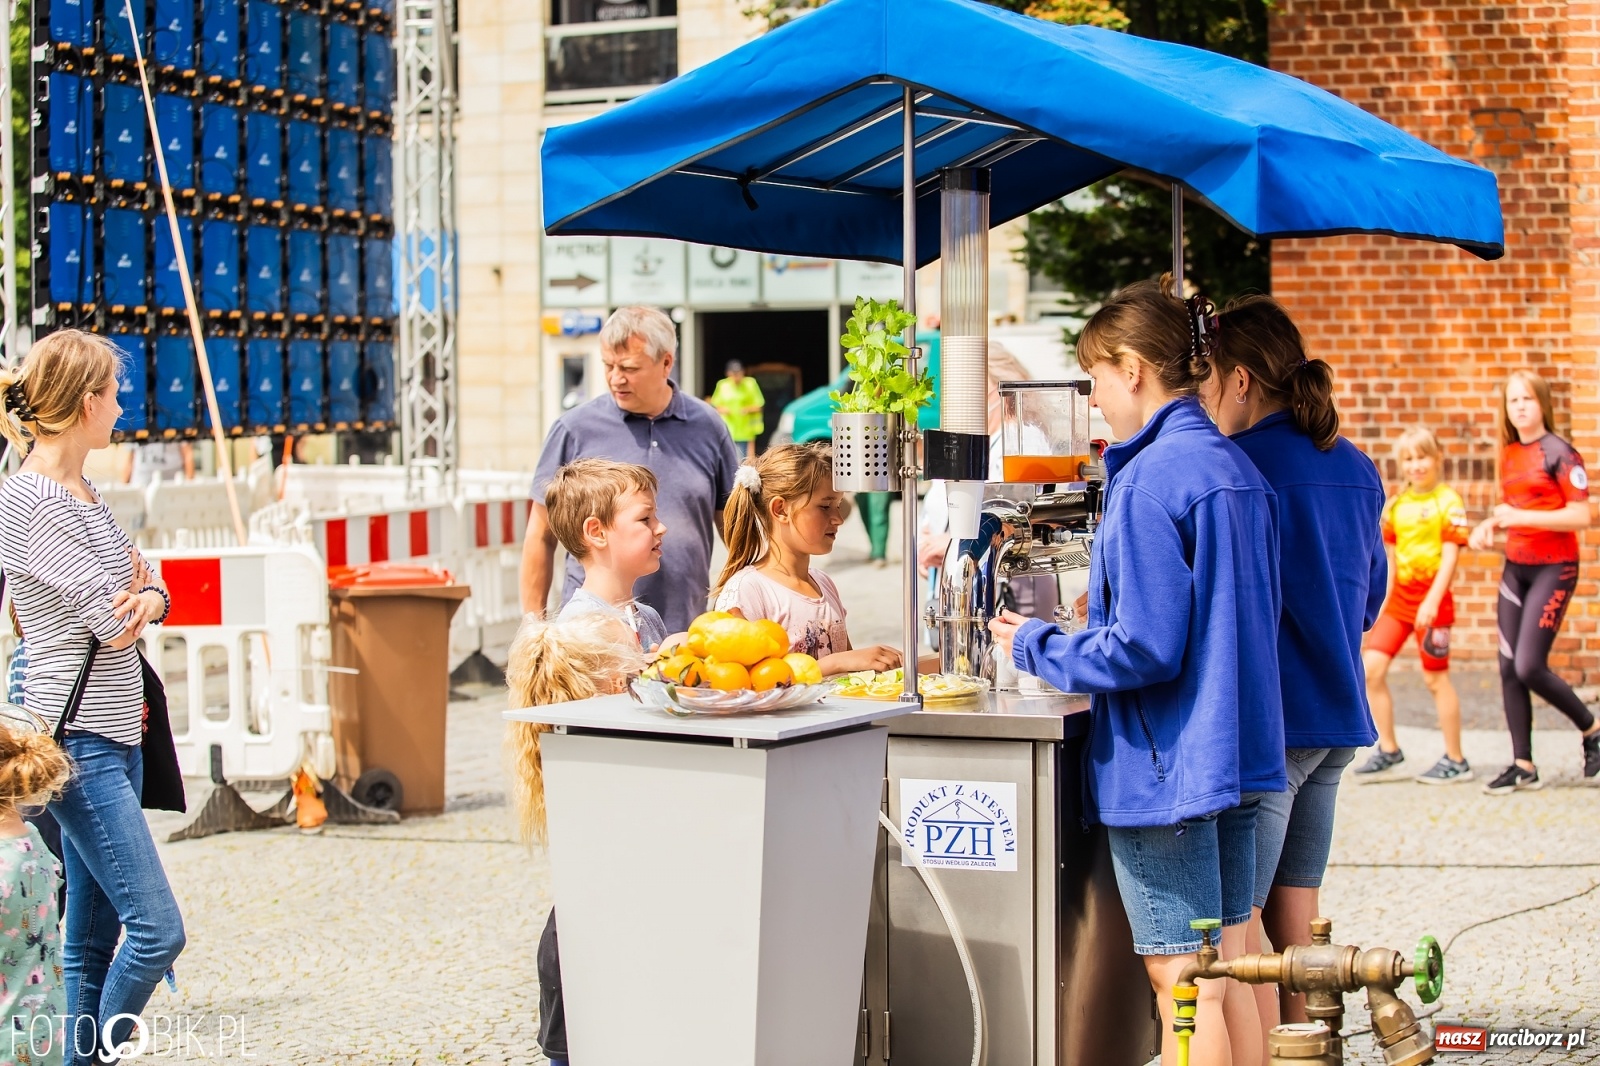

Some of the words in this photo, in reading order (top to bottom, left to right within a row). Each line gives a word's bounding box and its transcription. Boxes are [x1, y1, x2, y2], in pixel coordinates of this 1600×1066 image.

[1538, 589, 1566, 628] RACE
[955, 784, 965, 796] Z
[969, 789, 1015, 852] ATESTEM
[924, 824, 995, 856] PZH
